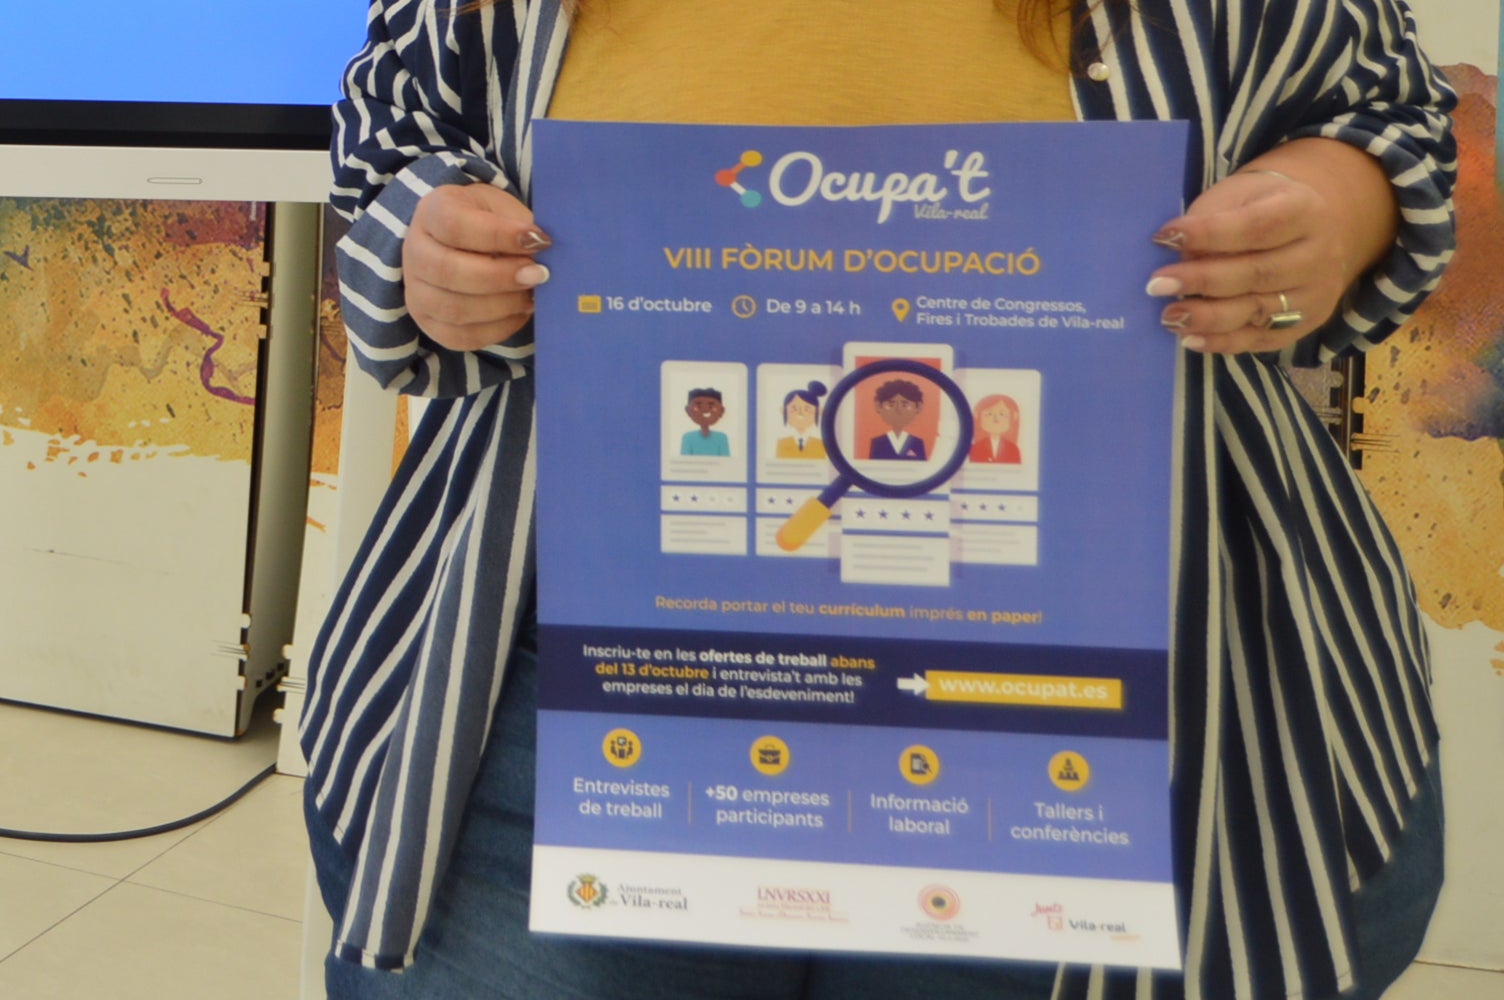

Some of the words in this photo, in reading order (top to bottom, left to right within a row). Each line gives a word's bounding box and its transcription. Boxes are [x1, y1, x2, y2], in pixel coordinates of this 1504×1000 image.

[769, 149, 991, 225] Ocupa't
[913, 202, 989, 220] Vila-real
[664, 247, 712, 269] VIII
[721, 243, 834, 271] FÒRUM
[843, 247, 1041, 275] D'OCUPACIÓ
[606, 296, 624, 310] 16
[627, 297, 712, 313] d'octubre
[766, 299, 791, 313] De
[795, 300, 806, 313] 9
[811, 303, 821, 314] a
[826, 300, 845, 314] 14
[849, 300, 861, 315] h
[917, 296, 967, 309] Centre
[971, 298, 991, 310] de
[994, 298, 1087, 314] Congressos,
[917, 312, 953, 325] Fires
[965, 313, 1034, 327] Trobades
[1039, 315, 1058, 328] de
[1062, 317, 1125, 329] Vila-real
[655, 596, 717, 611] Recorda
[721, 598, 768, 615] portar
[772, 600, 786, 613] el
[790, 602, 814, 615] teu
[967, 609, 987, 620] en
[992, 610, 1043, 625] paper!
[582, 644, 651, 660] Inscriu-te
[653, 650, 672, 661] en
[676, 648, 696, 662] les
[699, 649, 752, 664] ofertes
[755, 652, 775, 665] de
[778, 652, 827, 667] treball
[830, 655, 876, 670] abans
[595, 662, 618, 675] del
[622, 663, 636, 676] 13
[639, 664, 709, 679] d'octubre
[804, 671, 838, 686] amb
[841, 673, 862, 687] les
[602, 680, 673, 697] empreses
[675, 681, 689, 696] el
[692, 682, 715, 697] dia
[717, 684, 737, 699] de
[939, 678, 1108, 700] www.ocupat.es
[573, 778, 670, 798] Entrevistes
[706, 785, 739, 801] +50
[742, 789, 831, 807] empreses
[579, 801, 602, 816] de
[606, 803, 663, 818] treball
[870, 794, 969, 814] Informació
[1033, 802, 1095, 821] Tallers
[716, 808, 824, 829] participants
[889, 816, 950, 835] laboral
[1010, 825, 1130, 845] conferències
[620, 893, 688, 911] Vila-real
